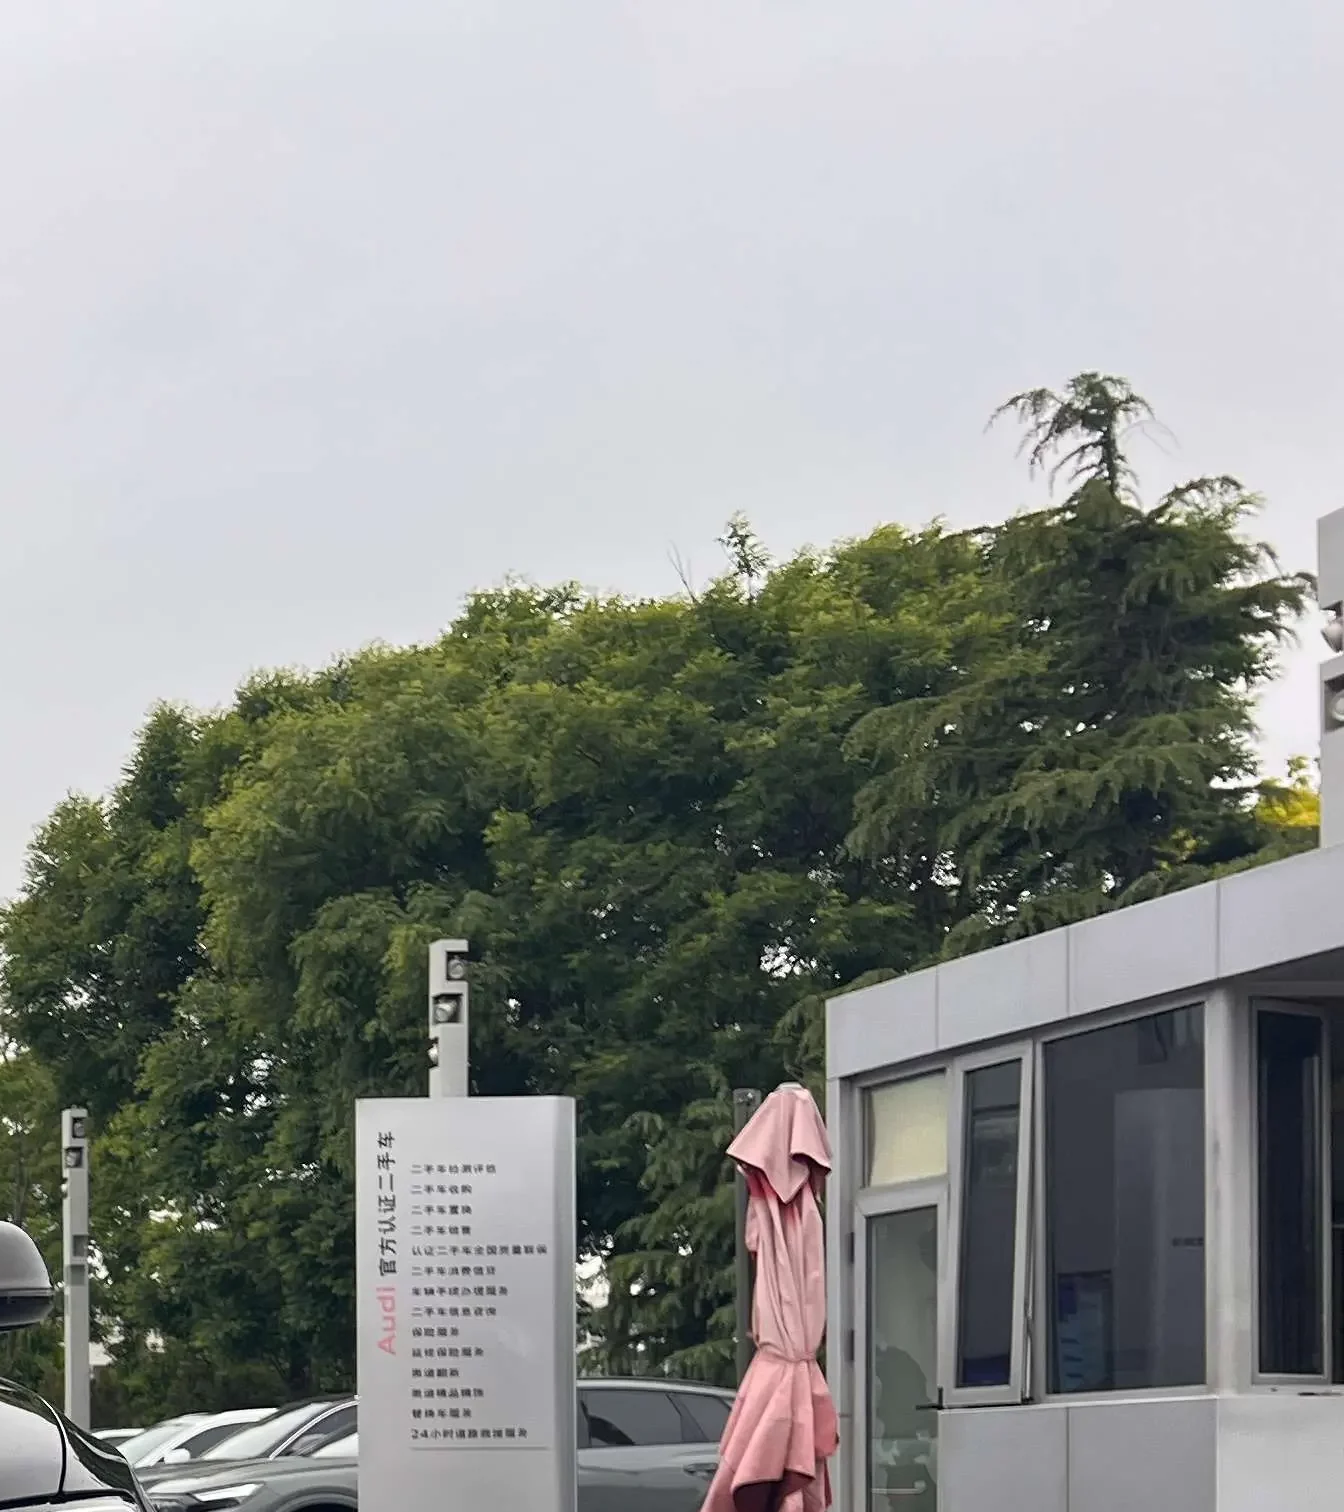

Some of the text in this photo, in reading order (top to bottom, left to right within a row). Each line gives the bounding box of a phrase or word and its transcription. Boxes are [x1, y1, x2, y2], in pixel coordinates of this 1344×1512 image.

[376, 1131, 397, 1356] Audi 官方认证二手车
